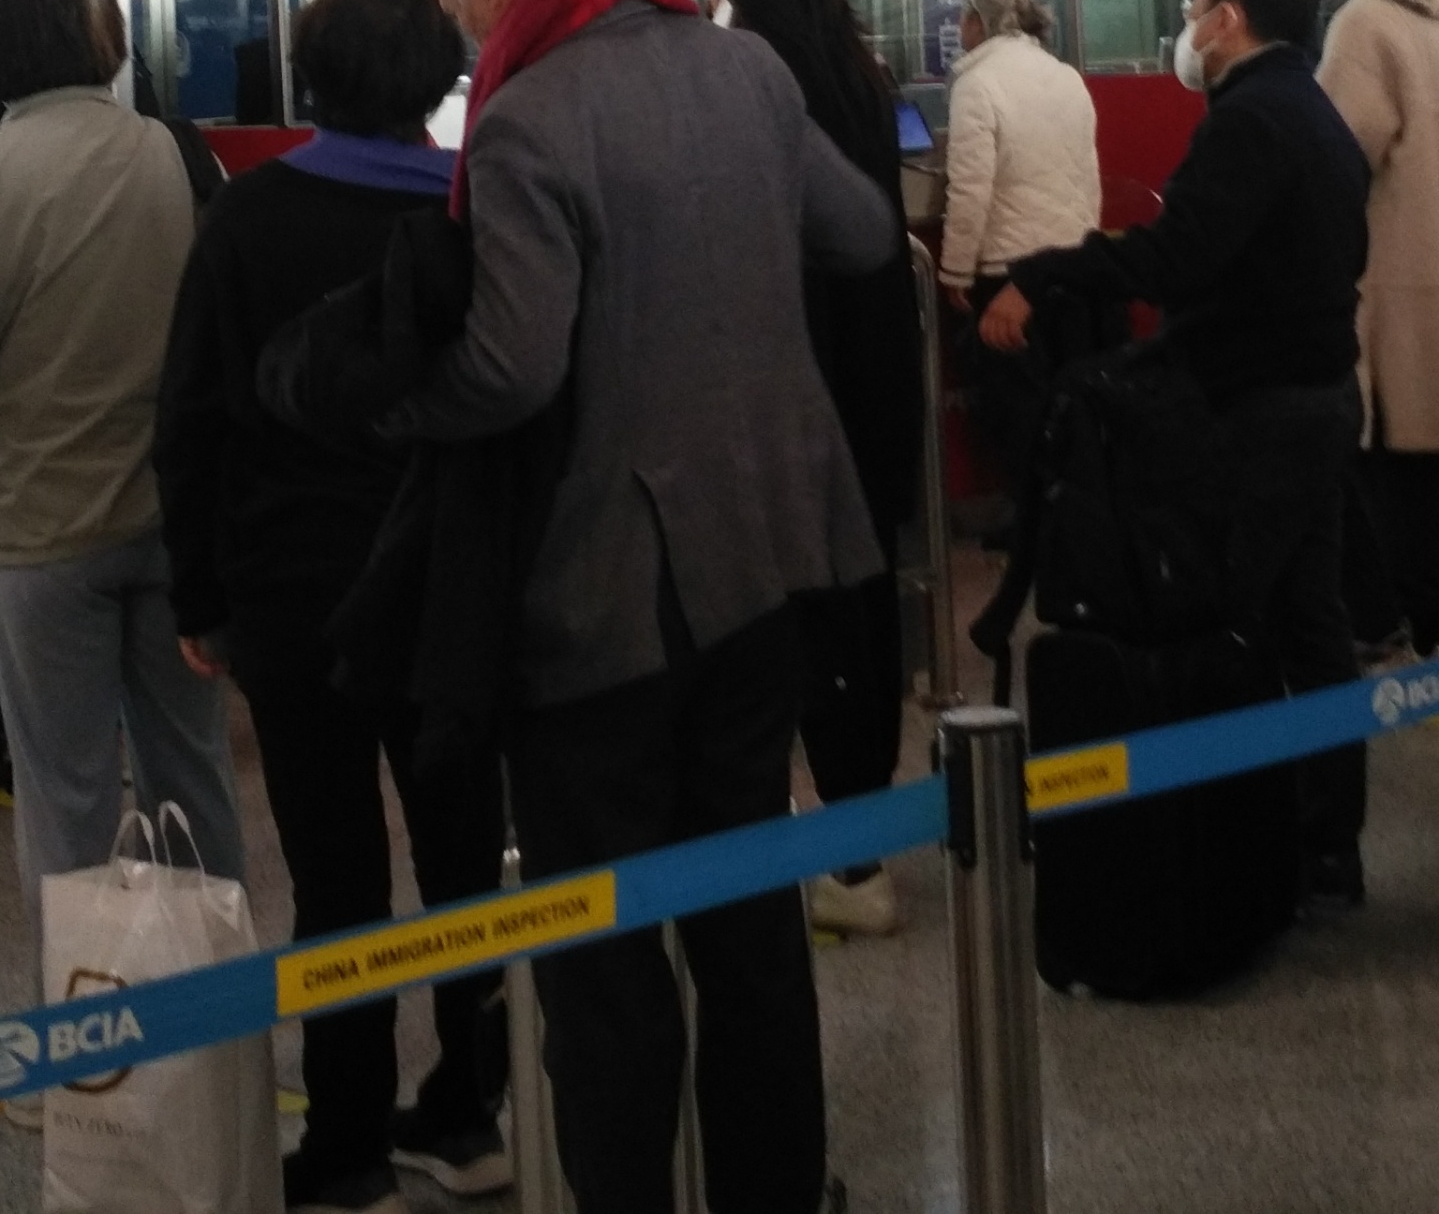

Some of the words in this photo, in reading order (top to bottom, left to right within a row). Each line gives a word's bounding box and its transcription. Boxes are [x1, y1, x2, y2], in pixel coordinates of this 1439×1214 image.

[302, 957, 361, 991] CHINA
[365, 921, 487, 973] IMMIGRATION
[491, 894, 592, 940] INSPECTION
[46, 1006, 145, 1063] BCIA
